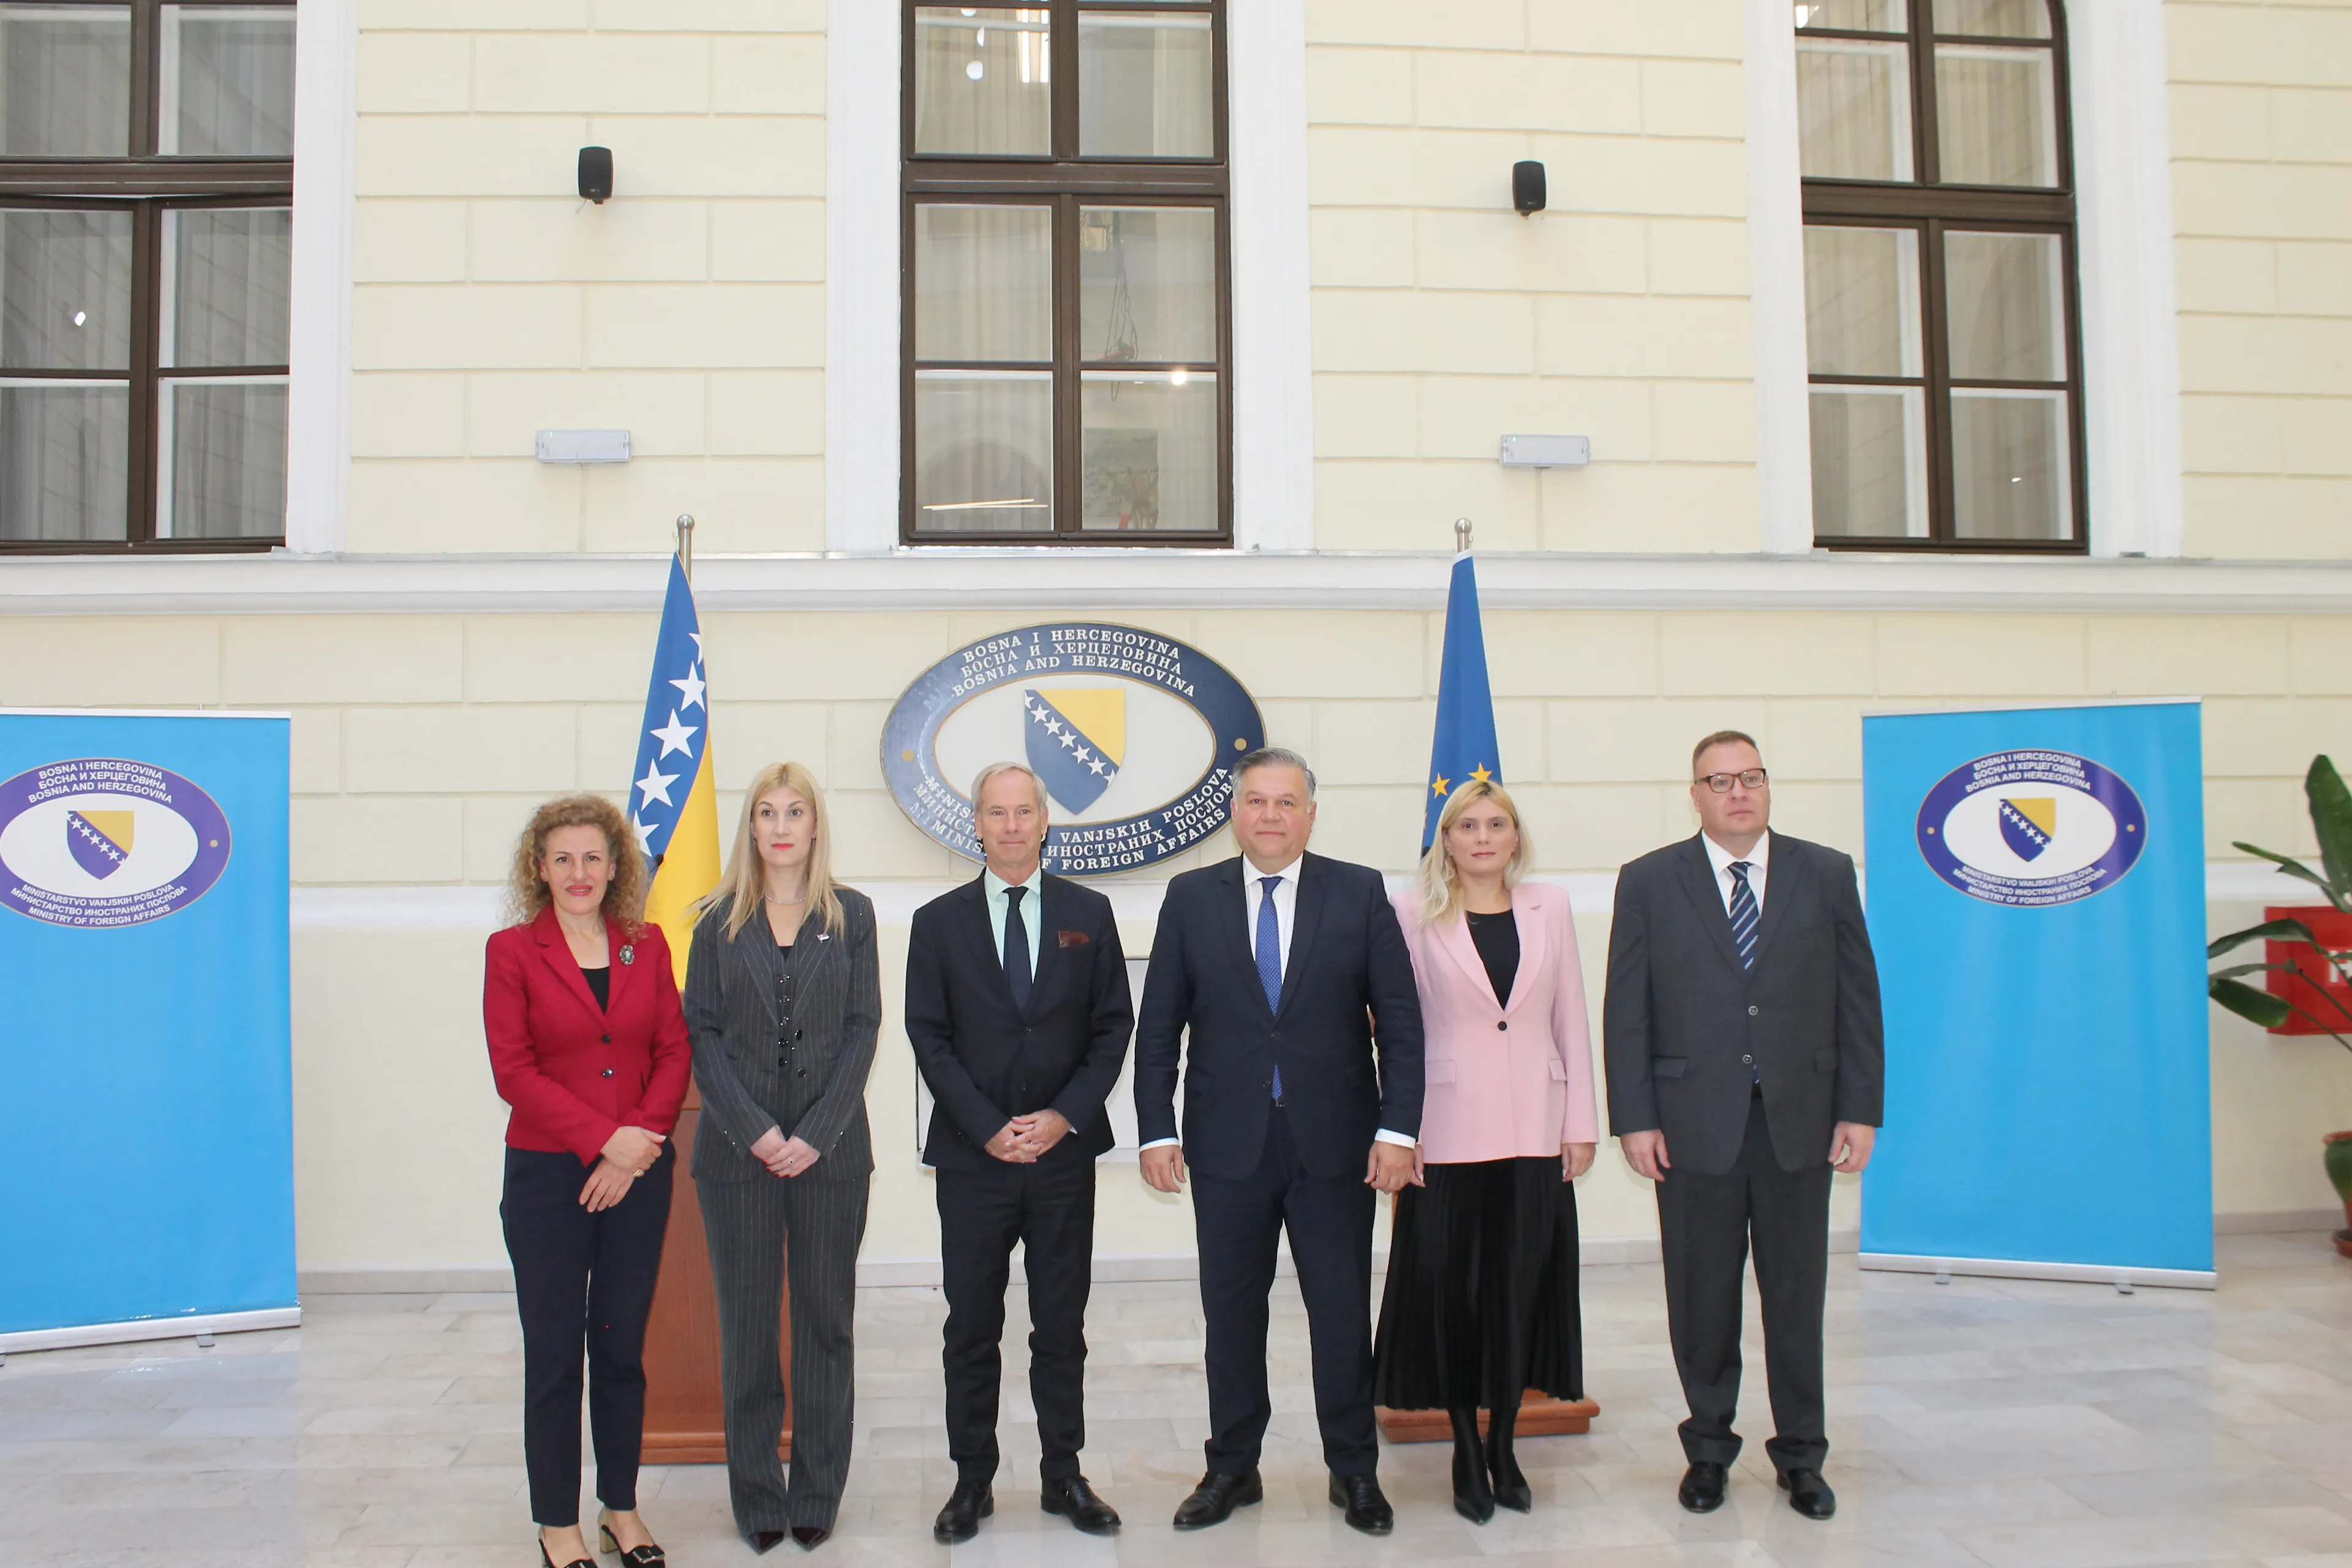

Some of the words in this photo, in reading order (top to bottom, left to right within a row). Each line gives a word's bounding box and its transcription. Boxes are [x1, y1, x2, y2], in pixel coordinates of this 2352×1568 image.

[963, 635, 1022, 663] BOSNA
[1032, 632, 1039, 643] I
[1051, 629, 1180, 660] HERCEGOVINA
[960, 650, 1019, 678] БОСНА
[1029, 644, 1041, 657] И
[1054, 643, 1181, 674] ХЕРЦЕГОВИНА
[952, 664, 1018, 697] BOSNIA
[1025, 657, 1060, 671] AND
[1072, 655, 1194, 697] HERZEGOVINA
[39, 763, 78, 780] BOSNA
[86, 761, 162, 780] HERCEGOVINA
[1973, 755, 2007, 771] BOSNA
[2014, 752, 2081, 767] HERCEGOVINA
[1973, 765, 2007, 780] БОСНА
[2008, 762, 2016, 771] И
[2016, 761, 2085, 778] ХЕРЦЕГОВИНА
[38, 773, 78, 790] БОСНА
[80, 771, 88, 781] И
[89, 771, 167, 791] ХЕРЦЕГОВИНА
[1965, 775, 2002, 793] BOSNIA
[2002, 771, 2022, 782] AND
[2024, 771, 2091, 790] HERZEGOVINA
[28, 786, 70, 804] BOSNIA
[71, 782, 95, 793] AND
[97, 782, 172, 804] HERZEGOVINA
[1047, 829, 1166, 857] ИНОСТРАНИХ
[1174, 774, 1232, 832] ПОСЛОВ
[1060, 819, 1152, 843] VANJSKIH
[1162, 767, 1228, 824] POSLOVA
[1061, 850, 1145, 870] FOREIGN
[1157, 808, 1226, 855] AFFAIRS
[1952, 868, 2014, 894] МИНИСТАРСТВО
[2015, 885, 2068, 896] ИНОСТРАНИХ
[2069, 869, 2107, 889] ПОСЛОВА
[1961, 865, 2018, 886] MINISTARSTVO
[2019, 879, 2057, 888] VANJSKIH
[2057, 867, 2095, 884] POSLOVA
[10, 887, 83, 916] МИНИСТАРСТВО
[85, 904, 145, 917] ИНОСТРАНИХ
[147, 886, 188, 909] ПОСЛОВА
[22, 884, 87, 907] MINISTARSTVO
[89, 896, 133, 907] VANJSKIH
[134, 884, 175, 903] POSLOVA
[1967, 885, 2006, 902] MINISTRY
[2020, 892, 2056, 904] FOREIGN
[2057, 886, 2092, 902] AFFAIRS
[28, 906, 73, 924] MINISTRY
[89, 914, 132, 925] FOREIGN
[133, 904, 171, 922] AFFAIRS
